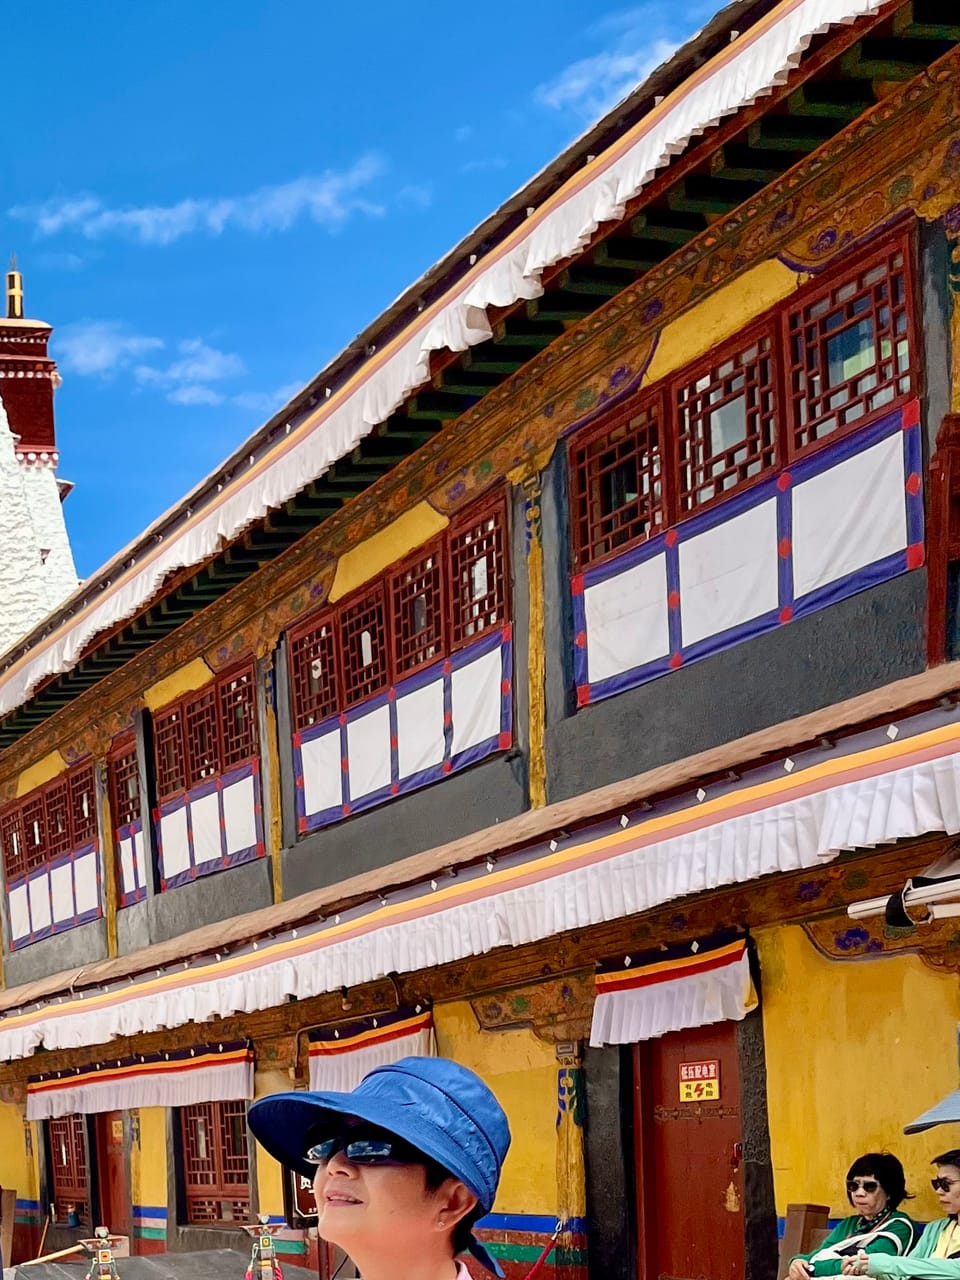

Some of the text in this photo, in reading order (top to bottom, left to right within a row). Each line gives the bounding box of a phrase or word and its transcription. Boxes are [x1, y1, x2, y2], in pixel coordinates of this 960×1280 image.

[681, 1064, 716, 1080] 低压配电室
